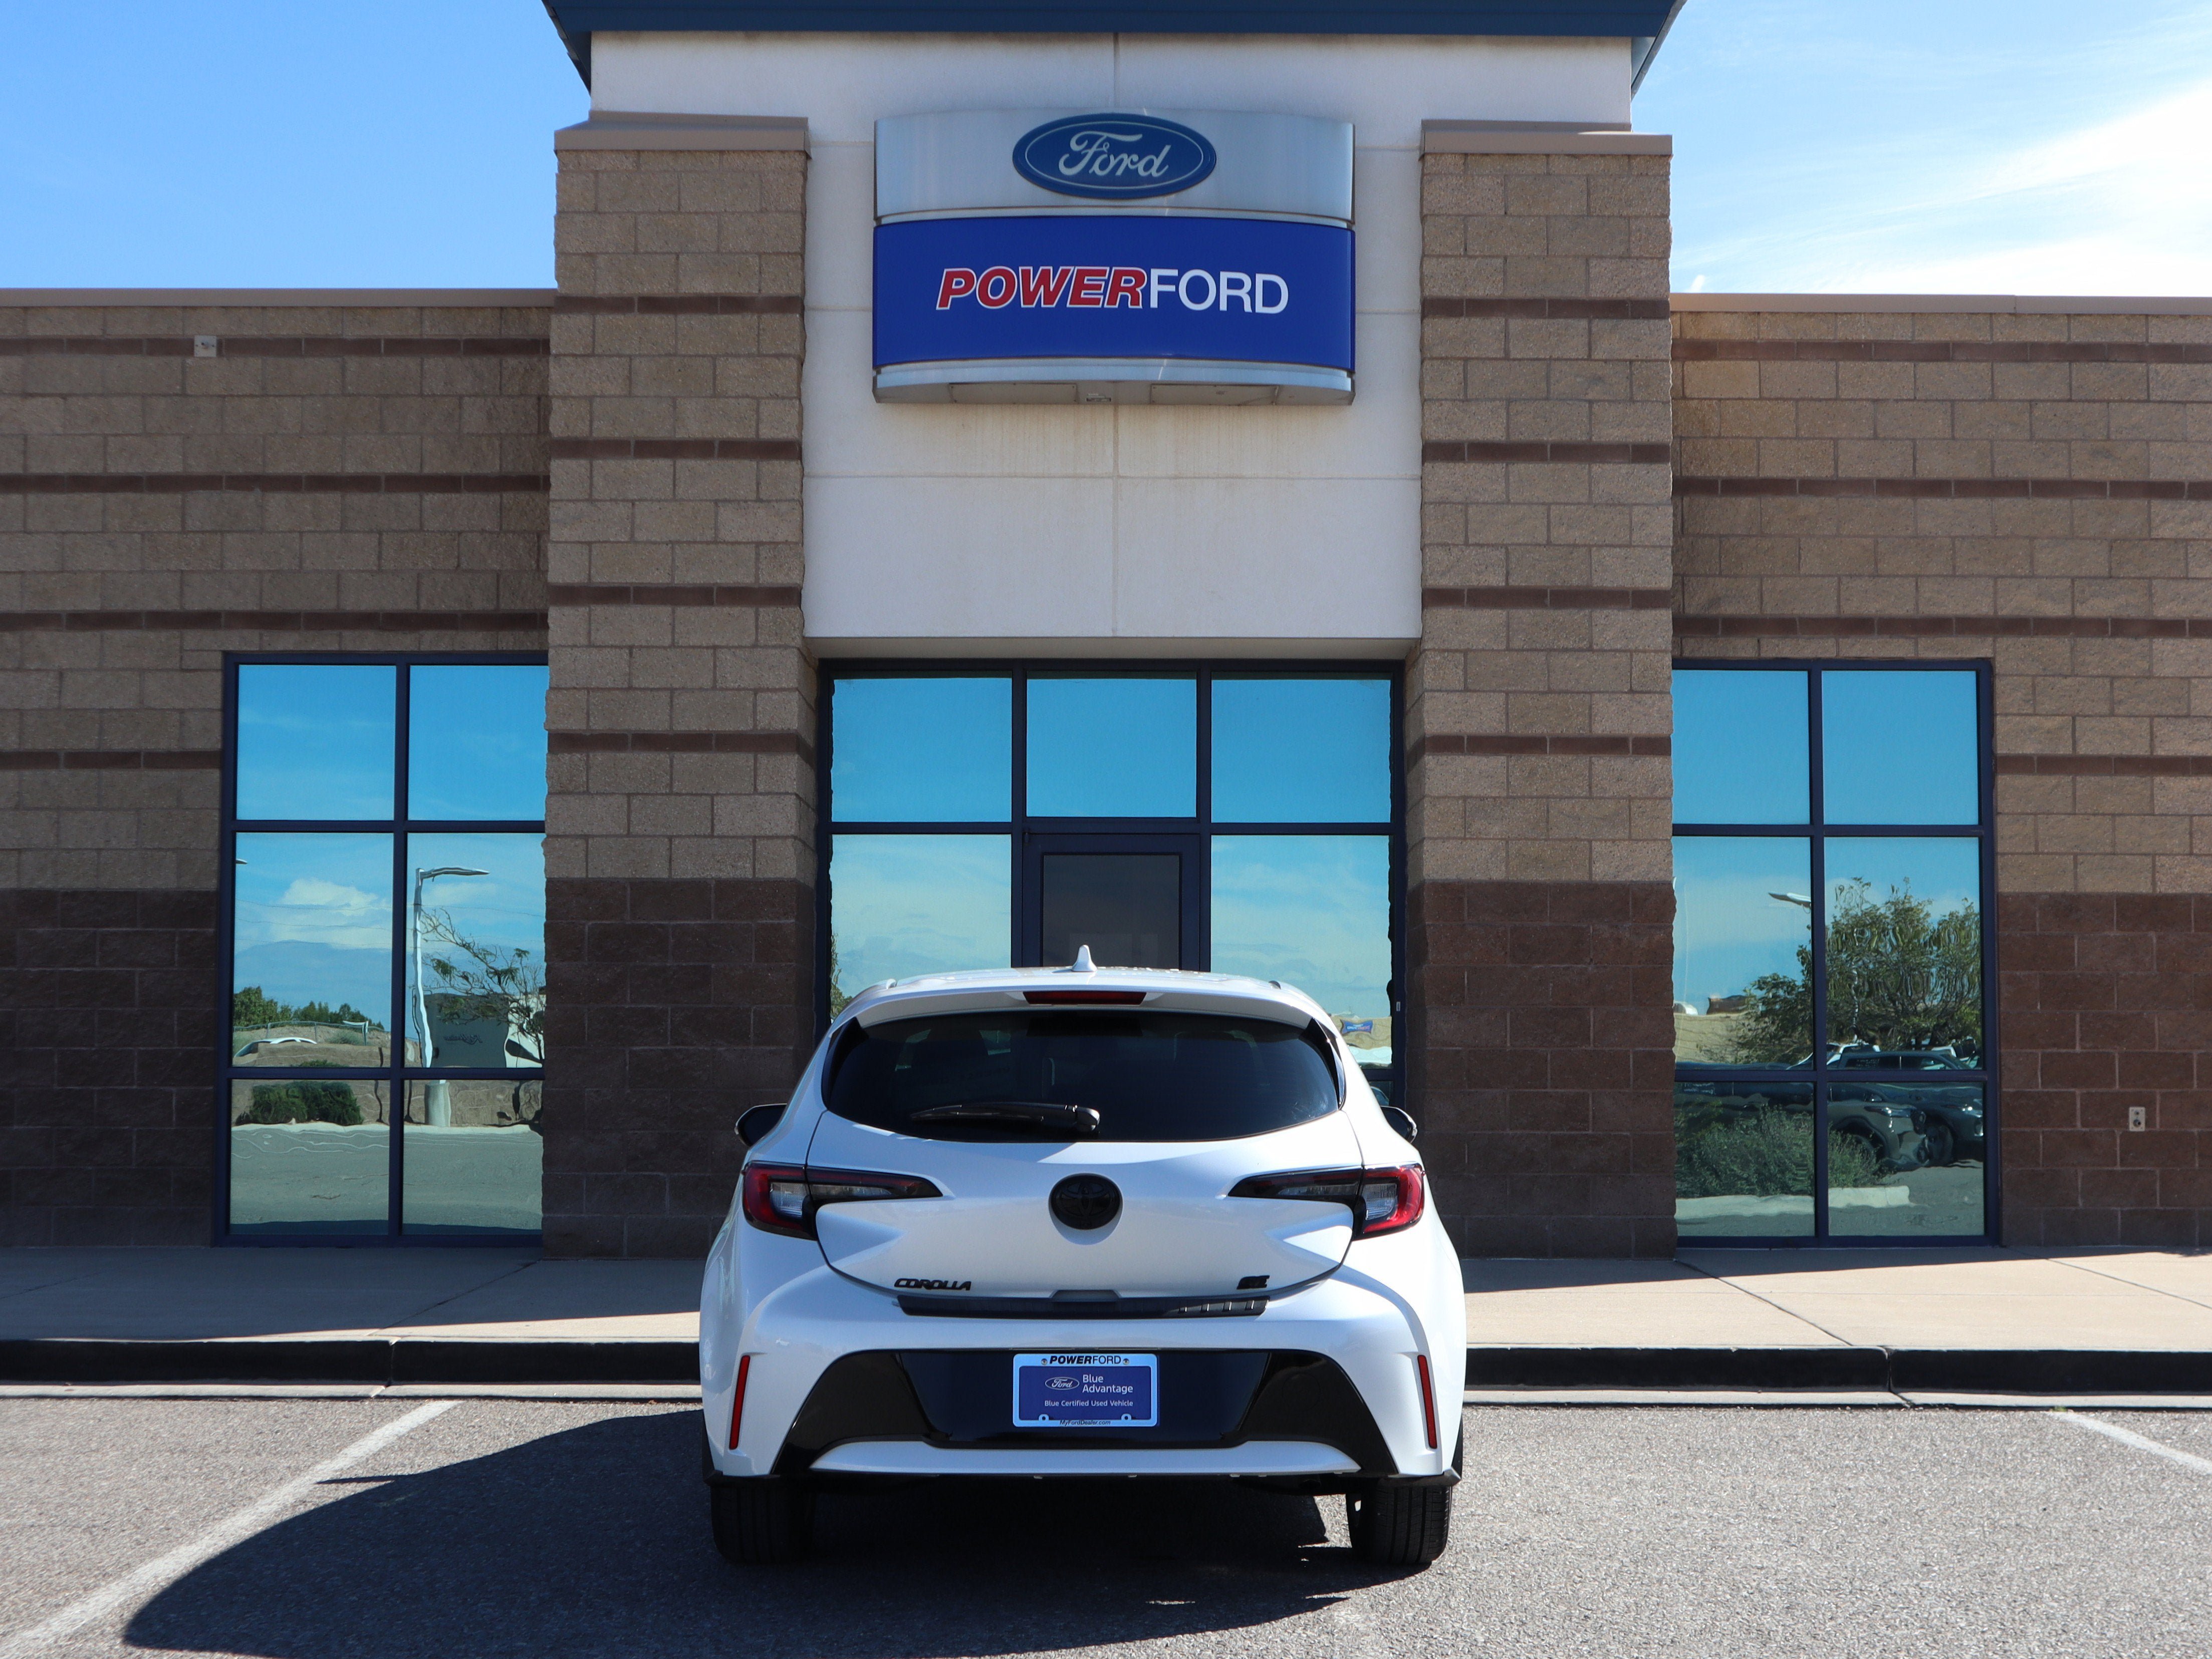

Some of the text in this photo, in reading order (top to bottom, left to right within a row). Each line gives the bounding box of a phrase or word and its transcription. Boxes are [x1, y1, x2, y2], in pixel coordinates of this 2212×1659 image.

[1058, 131, 1171, 178] Ford
[936, 265, 1289, 314] POWERFORD
[894, 1278, 972, 1291] COROLLA
[1049, 1355, 1121, 1364] POWERFORD
[1051, 1378, 1073, 1388] Ford
[1082, 1374, 1104, 1384] Blue
[1082, 1384, 1134, 1395] Advantage
